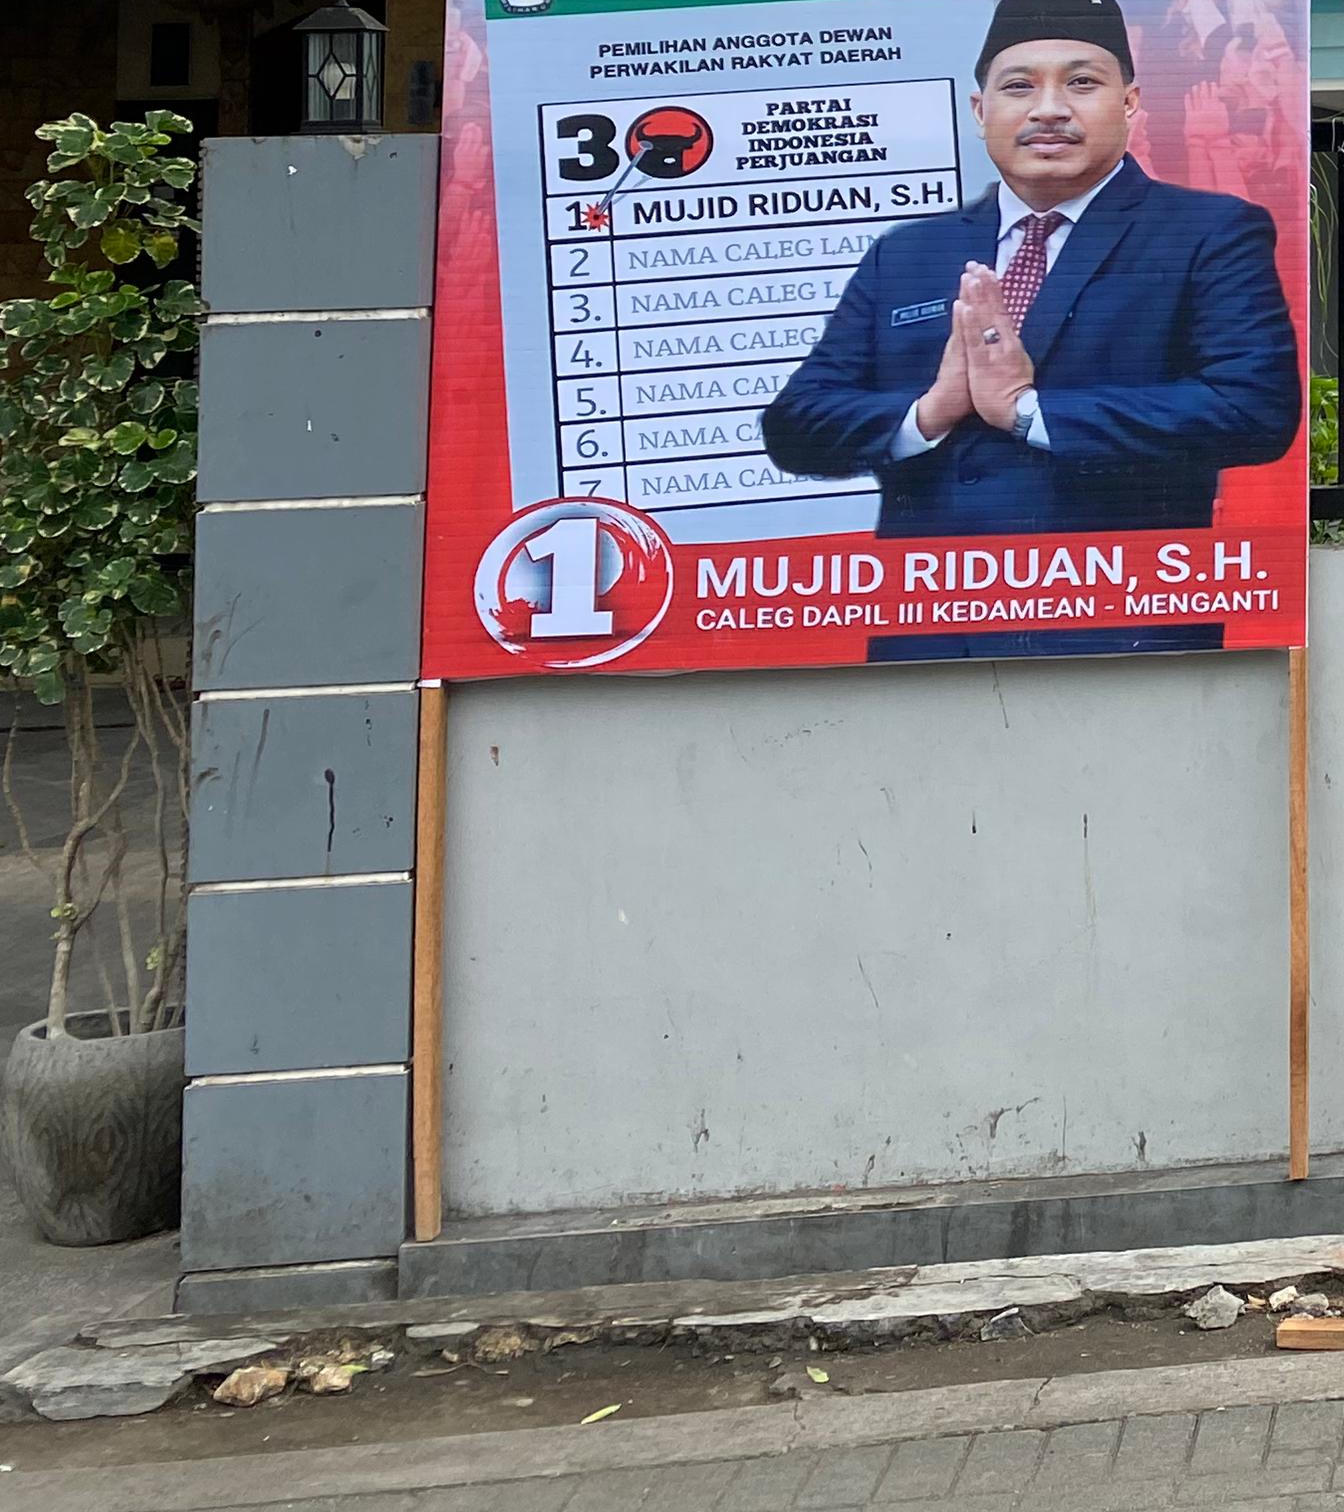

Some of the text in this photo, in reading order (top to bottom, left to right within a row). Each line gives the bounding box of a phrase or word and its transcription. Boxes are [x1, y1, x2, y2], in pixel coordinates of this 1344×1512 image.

[599, 26, 893, 59] PEMILIHAN ANGGOTA DEWAN
[590, 46, 902, 80] PERWAKILAN RAKYAT DAERAH
[742, 113, 879, 136] DEMOKRASI
[766, 98, 852, 117] PARTAI
[556, 113, 621, 182] 3
[736, 148, 888, 171] PERJUANGAN
[748, 131, 875, 153] INDONESIA
[634, 194, 738, 225] MUJID
[749, 186, 880, 217] RIDUAN,
[890, 181, 954, 207] S.H.
[569, 248, 591, 278] 2
[628, 243, 718, 270] NAMA
[725, 233, 814, 263] CALEG
[570, 293, 602, 323] 3.
[631, 286, 720, 314] NAMA
[727, 281, 816, 307] CALEG
[570, 326, 819, 369] 4. NAMA CALEG
[576, 387, 607, 417] 5.
[636, 377, 726, 405] NAMA
[576, 429, 609, 459] 6.
[639, 424, 730, 450] NAMA
[641, 469, 732, 496] NAMA
[522, 517, 614, 640] 1
[696, 541, 1268, 600] MUJID RIDUAN, S.H.
[696, 603, 795, 631] CALEG
[802, 601, 891, 628] DAPIL
[898, 601, 924, 625] III
[932, 595, 1095, 624] KEDAMEAN
[1124, 587, 1280, 618] MENGANTI
